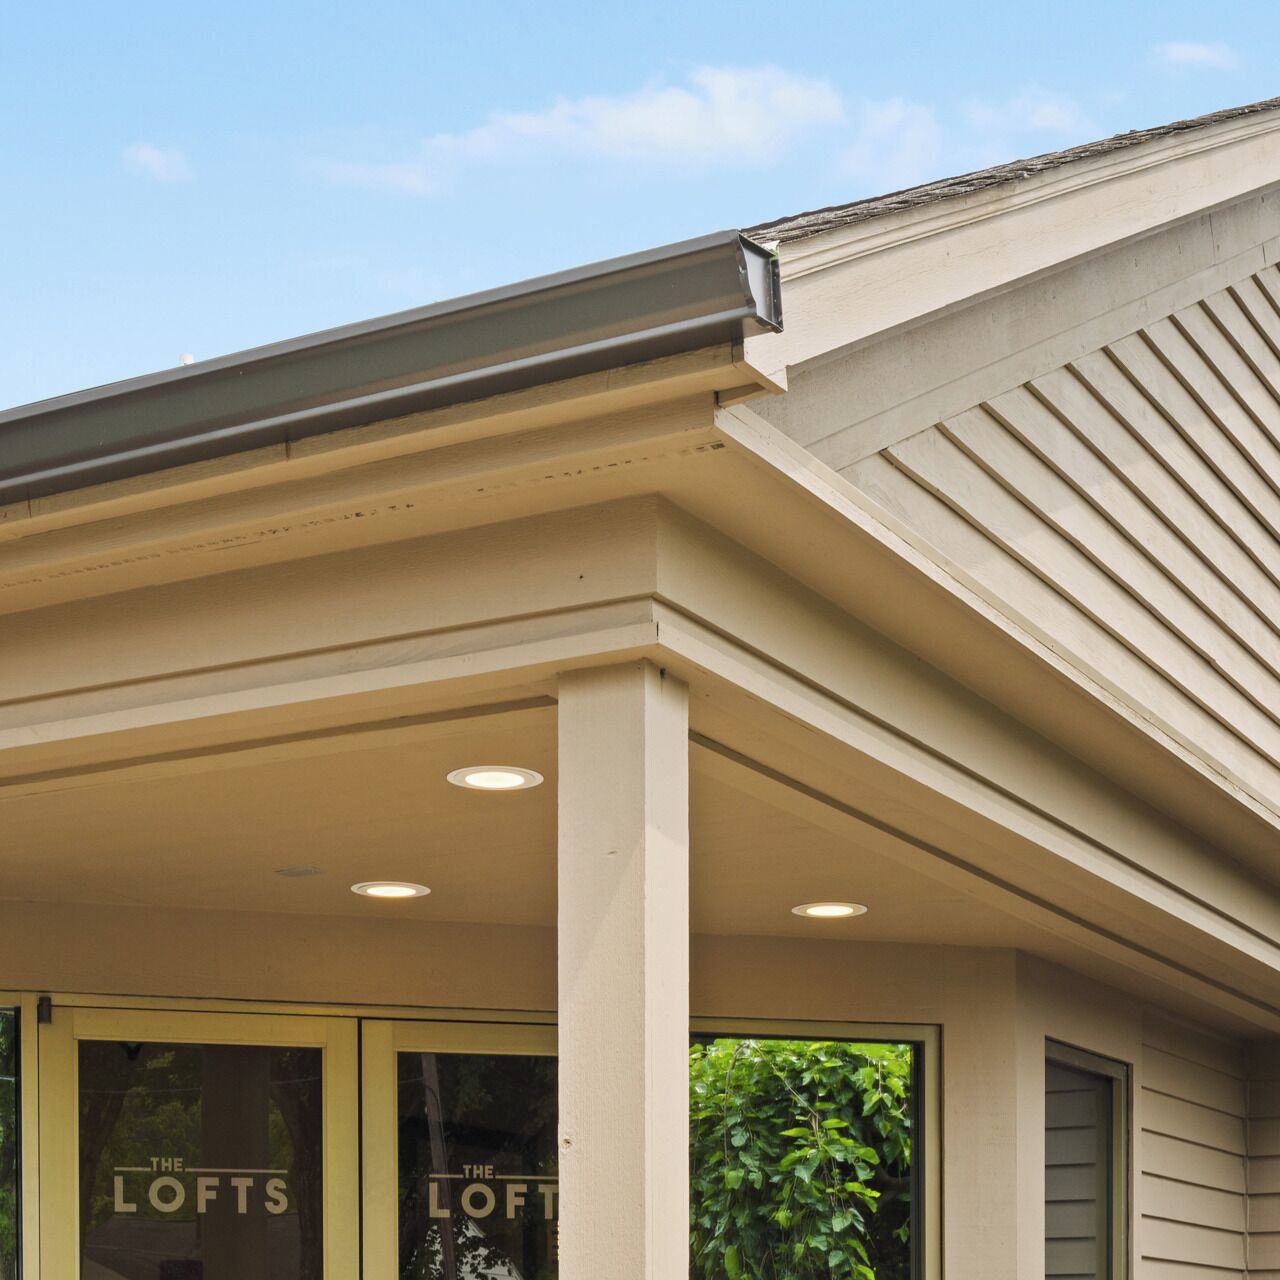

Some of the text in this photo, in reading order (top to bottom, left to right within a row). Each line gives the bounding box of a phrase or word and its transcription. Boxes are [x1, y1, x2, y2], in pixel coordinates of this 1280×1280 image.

[150, 1157, 183, 1172] THE
[463, 1164, 494, 1179] THE
[114, 1175, 288, 1214] LOFTS
